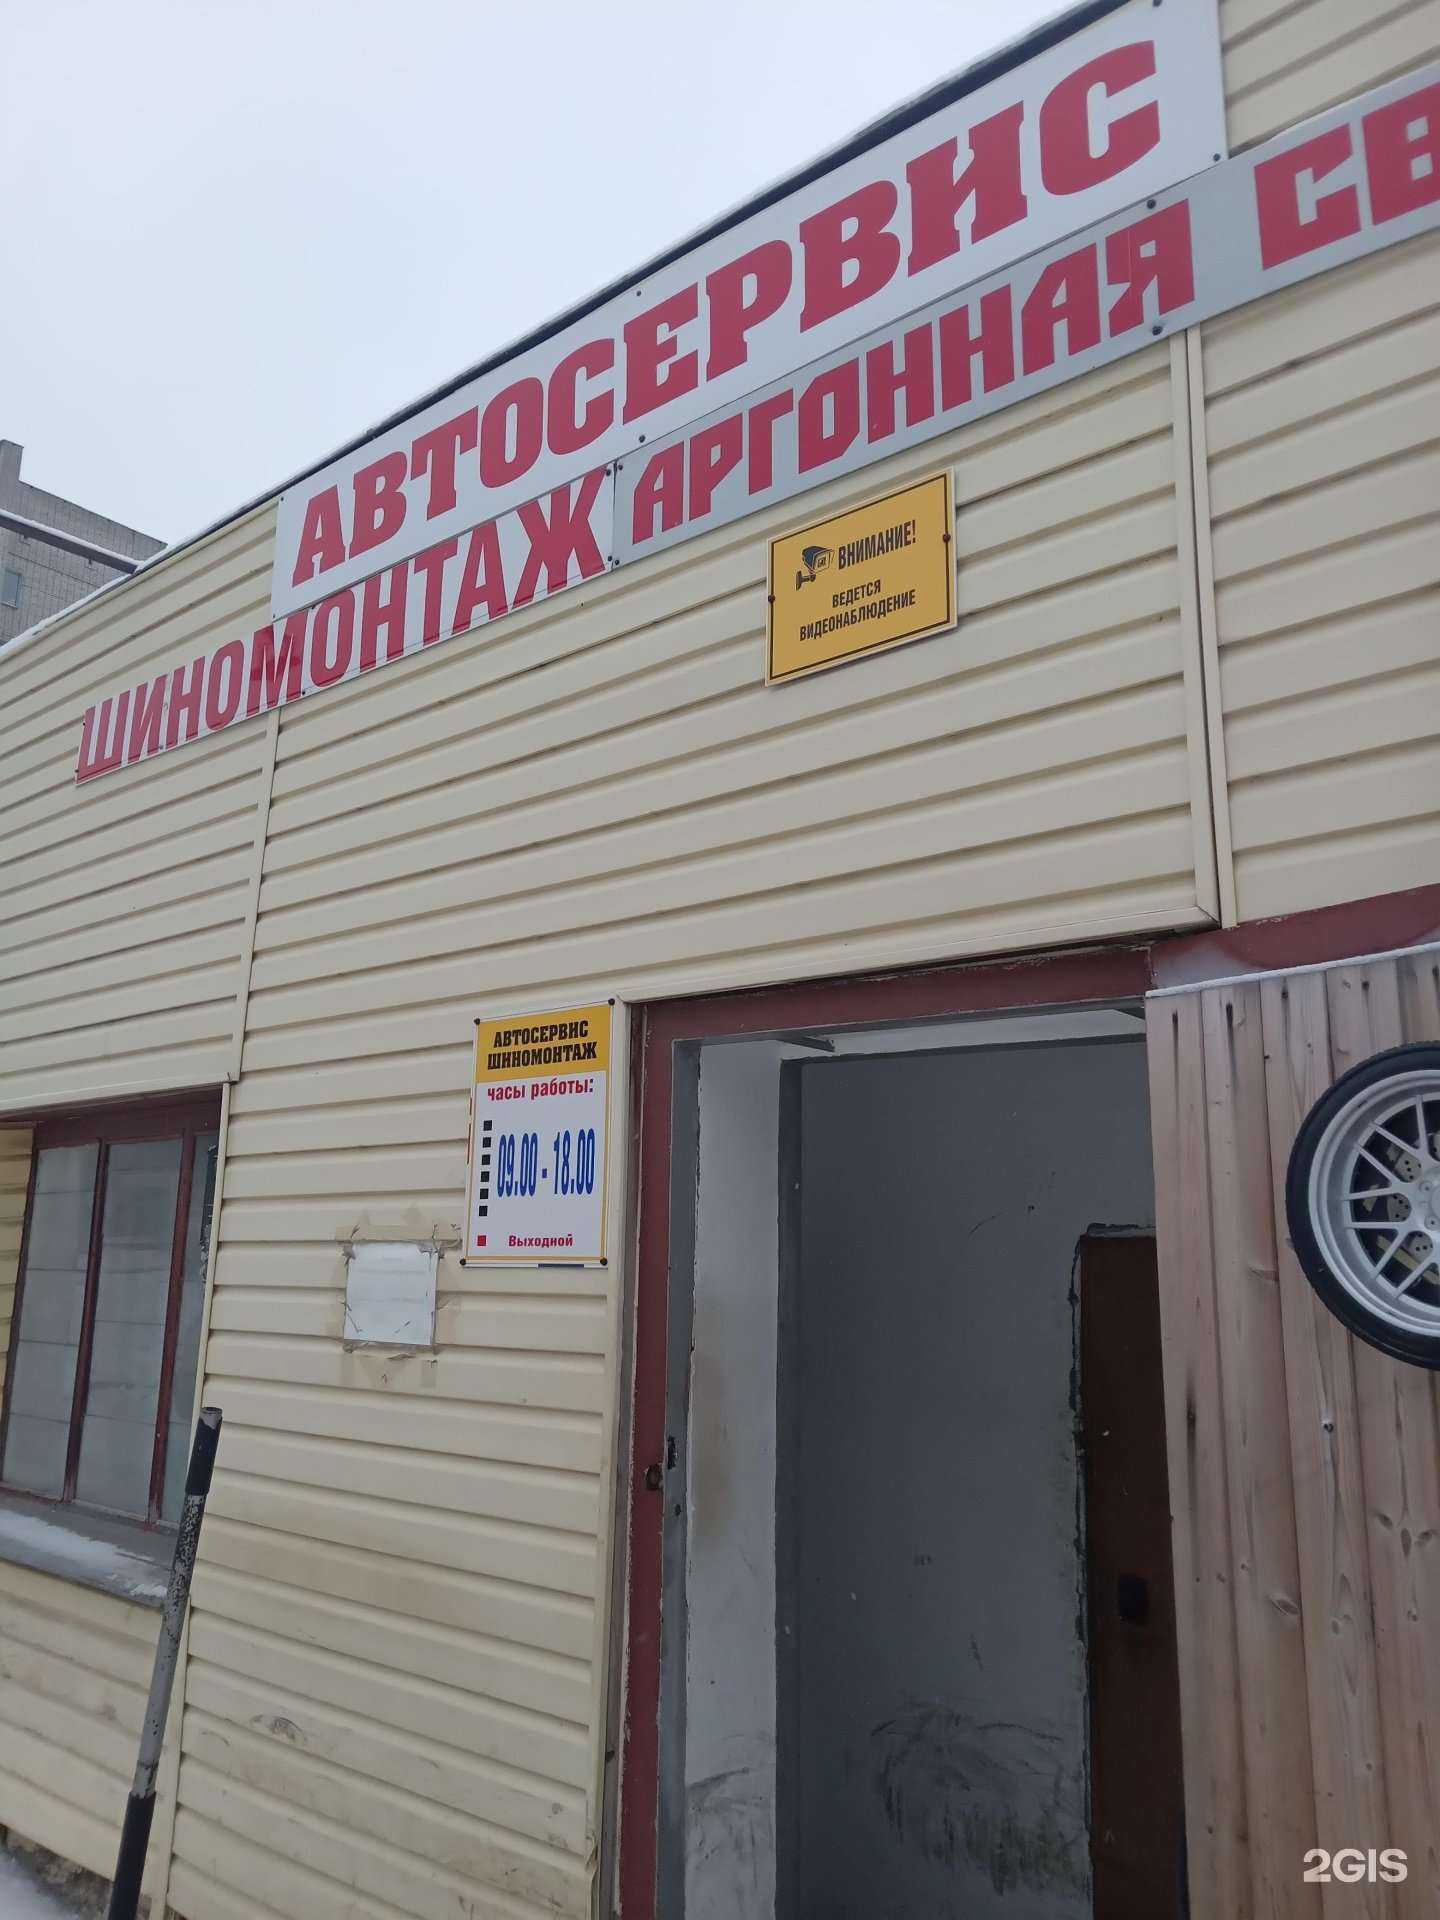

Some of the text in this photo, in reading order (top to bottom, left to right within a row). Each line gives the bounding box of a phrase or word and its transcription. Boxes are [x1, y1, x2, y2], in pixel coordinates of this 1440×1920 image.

[291, 39, 1161, 587] АВТОСЕРВИС
[632, 82, 1440, 546] АРГОННАЯ СВ
[837, 519, 917, 571] ВНИМАНИЕ!
[799, 588, 917, 642] ВИДЕОНАБЛЮДЕНИЕ
[832, 578, 882, 609] ВЕДЕТСЯ
[76, 464, 607, 785] ШИНОМОНТАЖ
[487, 1041, 598, 1071] ШИНОМОНТАЖ
[493, 1020, 589, 1049] АВТОСЕРВИС
[487, 1077, 594, 1102] часы работы:
[497, 1132, 538, 1198] 09.00
[553, 1127, 596, 1196] 18.00
[508, 1233, 574, 1248] Выходной
